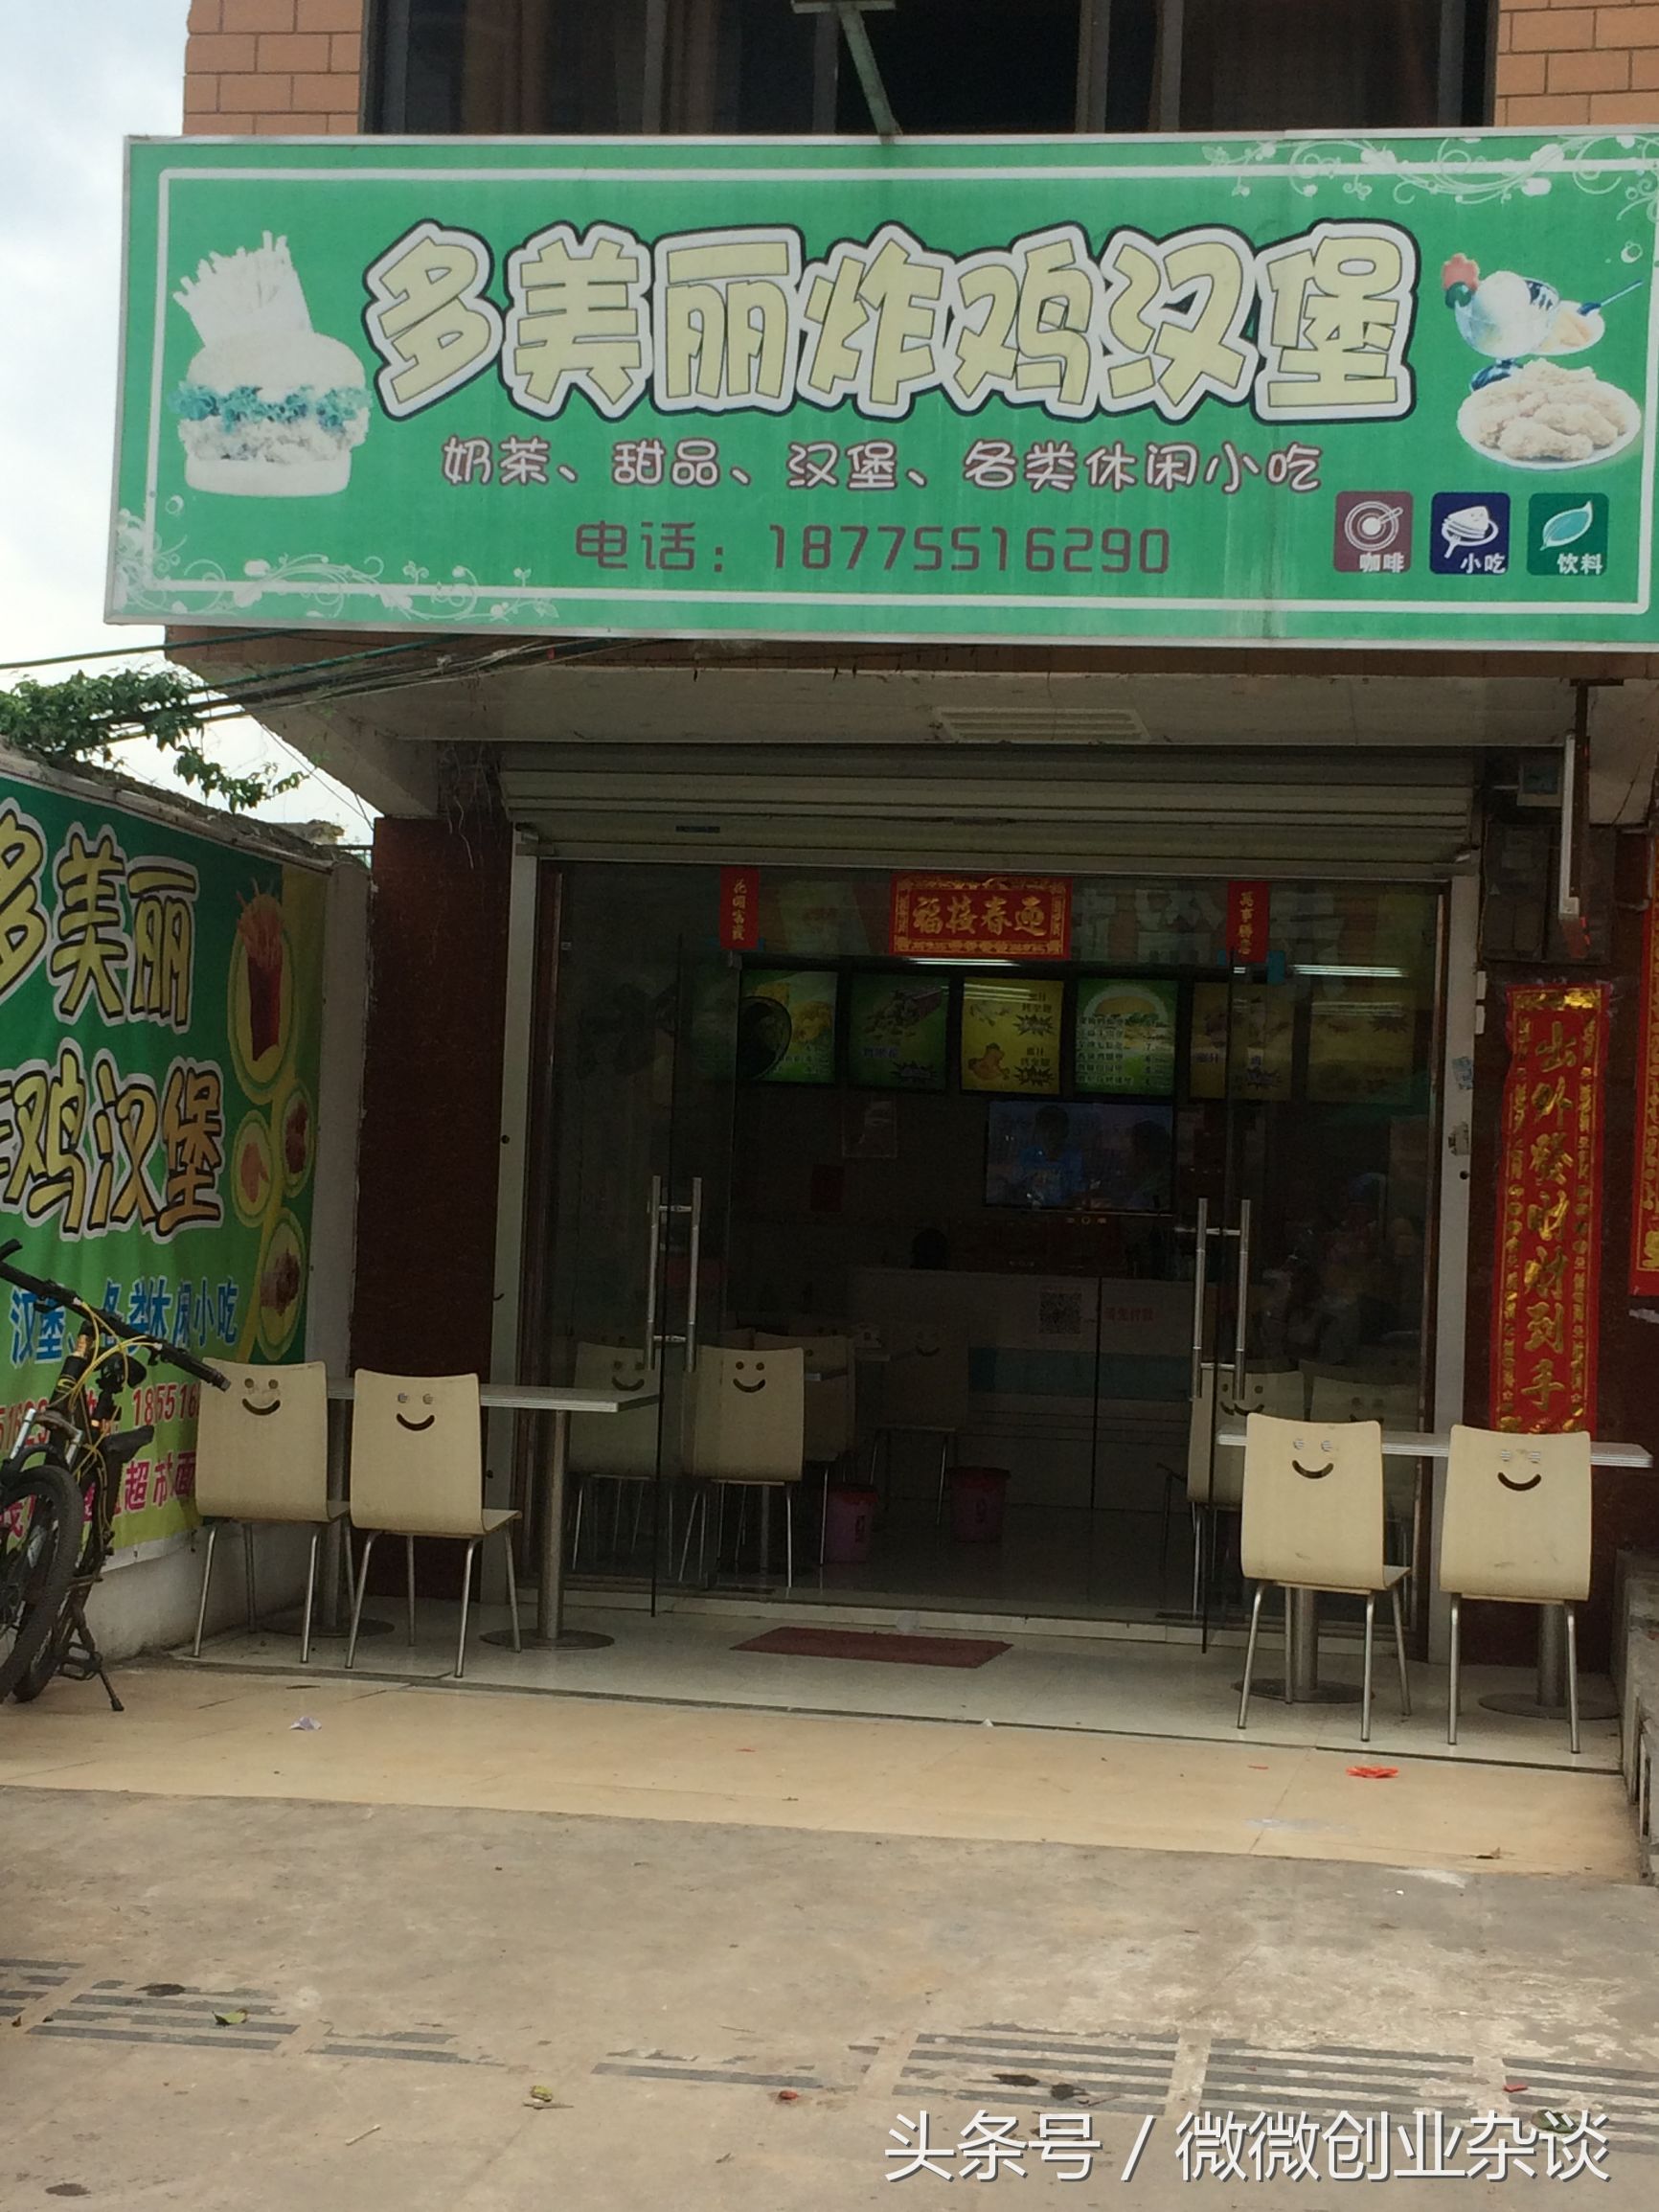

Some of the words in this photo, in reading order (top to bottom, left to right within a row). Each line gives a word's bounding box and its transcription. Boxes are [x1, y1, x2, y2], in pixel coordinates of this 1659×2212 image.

[365, 220, 1420, 422] 多美丽炸鸡汉堡
[443, 437, 1322, 492] 奶茶、甜品、汉堡、各类休闲小吃
[770, 524, 1170, 574] 18775516290
[1358, 552, 1405, 574] 咖啡
[1460, 553, 1506, 574] 小吃
[1557, 553, 1602, 575] 饮料
[0, 1038, 225, 1243] 鸡汉堡
